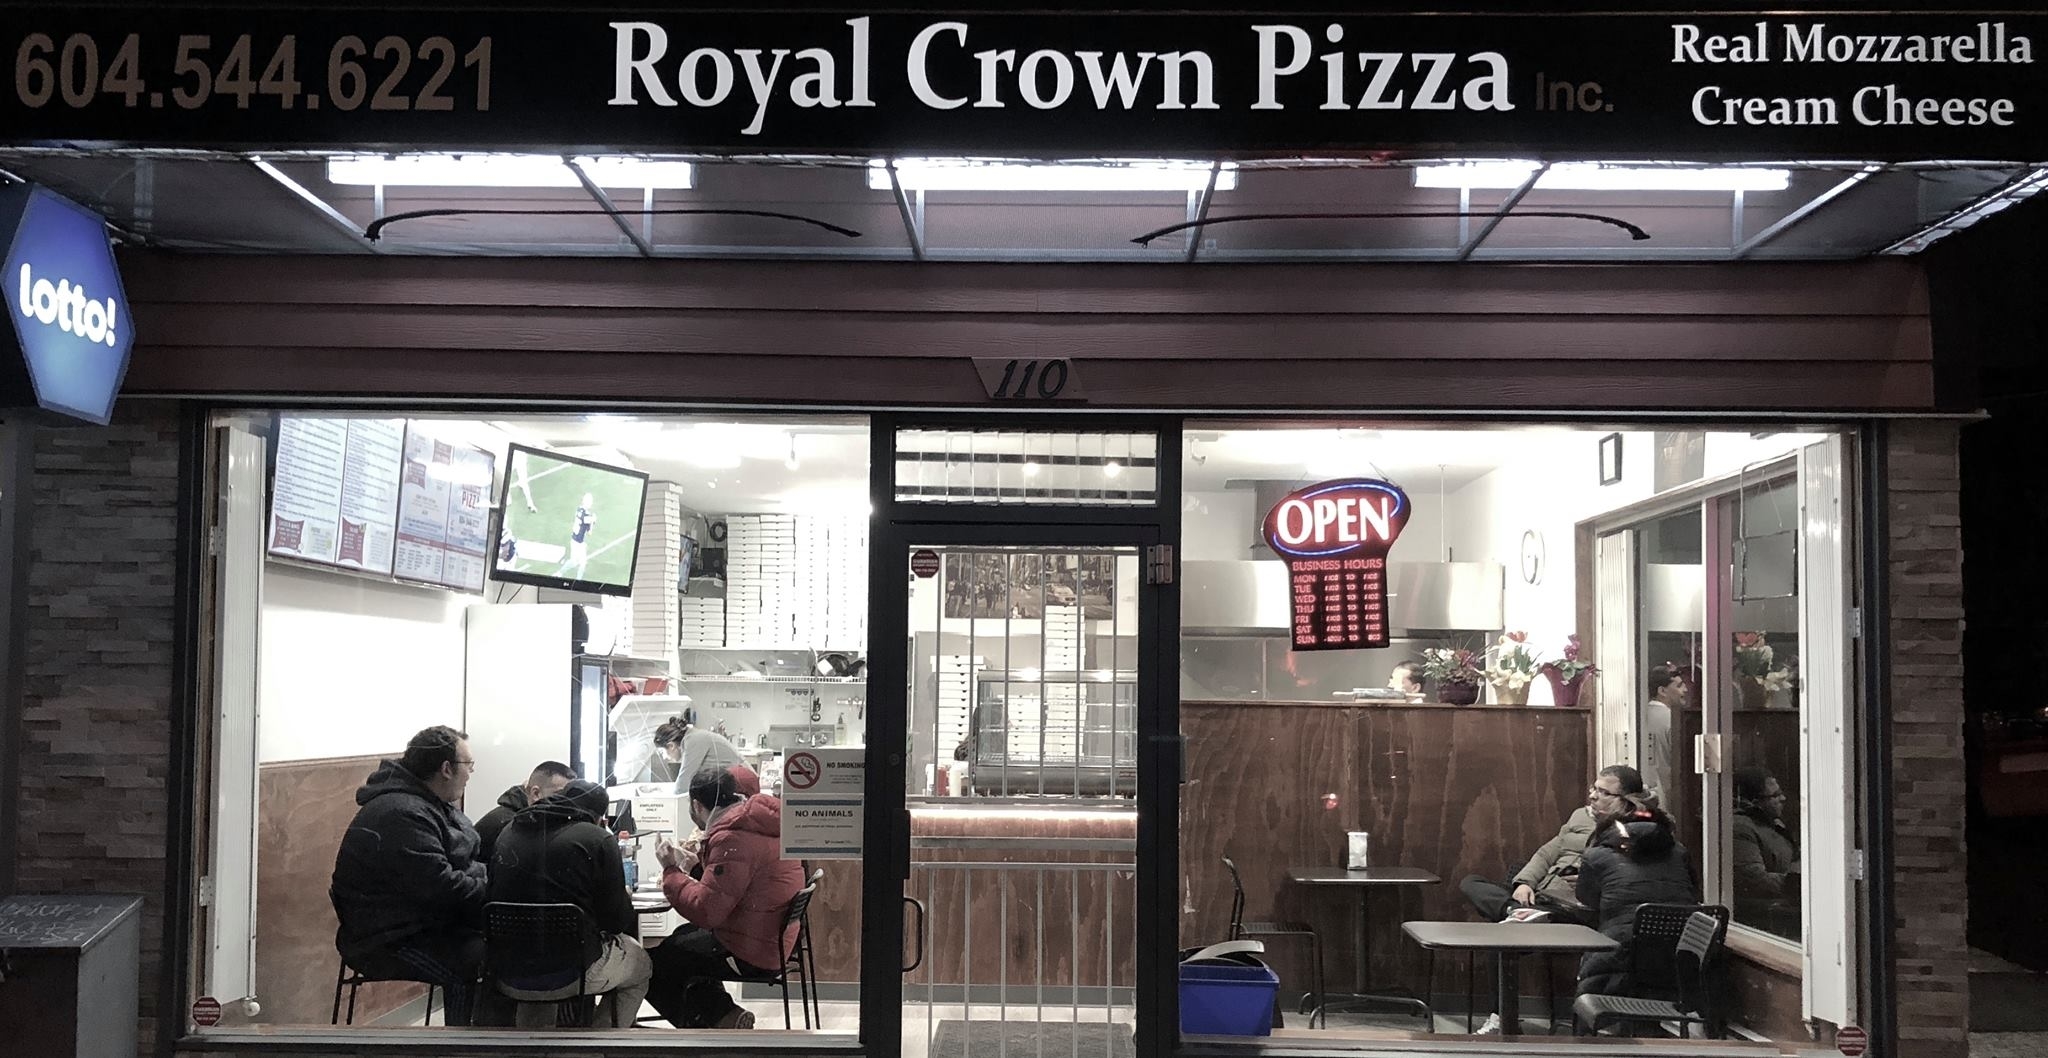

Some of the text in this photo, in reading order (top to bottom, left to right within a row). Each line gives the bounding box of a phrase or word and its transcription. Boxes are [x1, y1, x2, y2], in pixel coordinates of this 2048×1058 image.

[1671, 21, 2034, 64] Real Mozzarella
[15, 33, 492, 111] 604.544.6221
[607, 16, 1615, 135] Royal Crown Pizza Inc.
[1691, 83, 2015, 126] Cream Cheese
[19, 262, 116, 347] lotto!
[994, 360, 1068, 398] 110
[1277, 497, 1389, 544] OPEN
[1292, 558, 1383, 571] BUSINESS HOURS
[1294, 575, 1316, 583] MON
[1295, 585, 1311, 593] TUE
[1295, 605, 1314, 613] THU
[1296, 635, 1315, 644] SUN
[837, 761, 867, 769] SMOKING
[795, 810, 854, 818] NO ANIMALS
